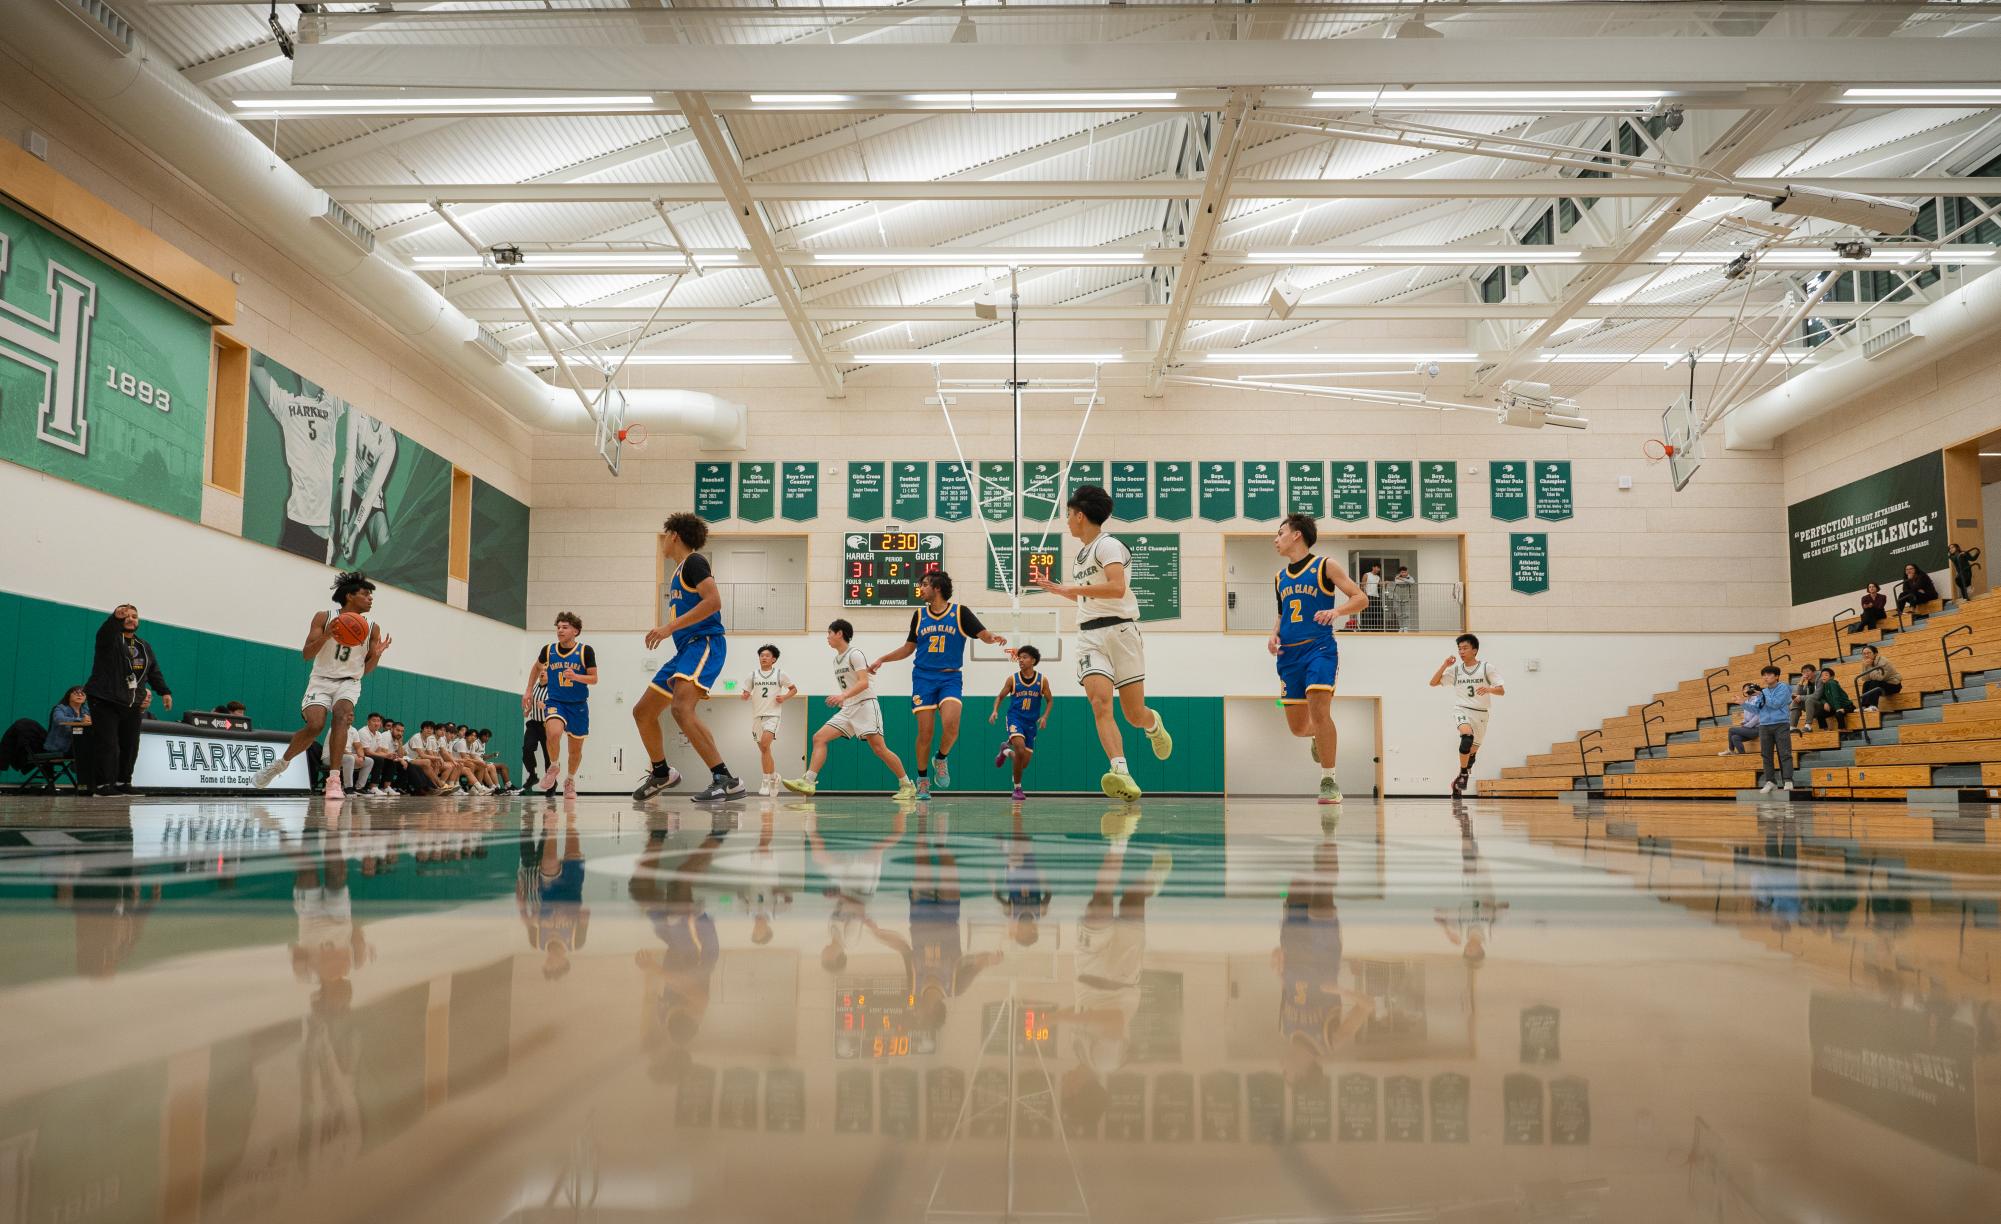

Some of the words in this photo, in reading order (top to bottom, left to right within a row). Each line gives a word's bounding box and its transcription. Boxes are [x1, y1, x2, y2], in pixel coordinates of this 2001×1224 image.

[107, 365, 170, 412] 1893
[309, 421, 316, 440] 5
[1874, 500, 1910, 518] ATTAINABLE,
[1810, 540, 1820, 548] BUT
[1828, 536, 1835, 544] WE
[1837, 530, 1853, 540] CHASE
[1855, 518, 1888, 534] PERFECTION
[882, 535, 916, 549] 2:30
[1907, 540, 1930, 551] LOMBARDI
[1812, 549, 1821, 557] CAN
[1822, 544, 1838, 554] CATCH
[1031, 555, 1053, 564] 2:30
[853, 563, 873, 578] 31
[890, 564, 898, 576] 2
[852, 586, 859, 597] 2
[867, 588, 873, 597] 5
[916, 588, 921, 597] 3
[1294, 584, 1318, 598] CLARA
[1290, 599, 1303, 623] 2
[920, 625, 936, 637] SANTA
[938, 625, 956, 635] CLARA
[928, 636, 945, 653] 21
[334, 644, 351, 662] 13
[564, 662, 580, 670] CLARA
[762, 688, 768, 698] 2
[1467, 686, 1474, 697] 3
[166, 740, 276, 772] HARKER
[200, 775, 218, 783] Home
[228, 775, 236, 783] the
